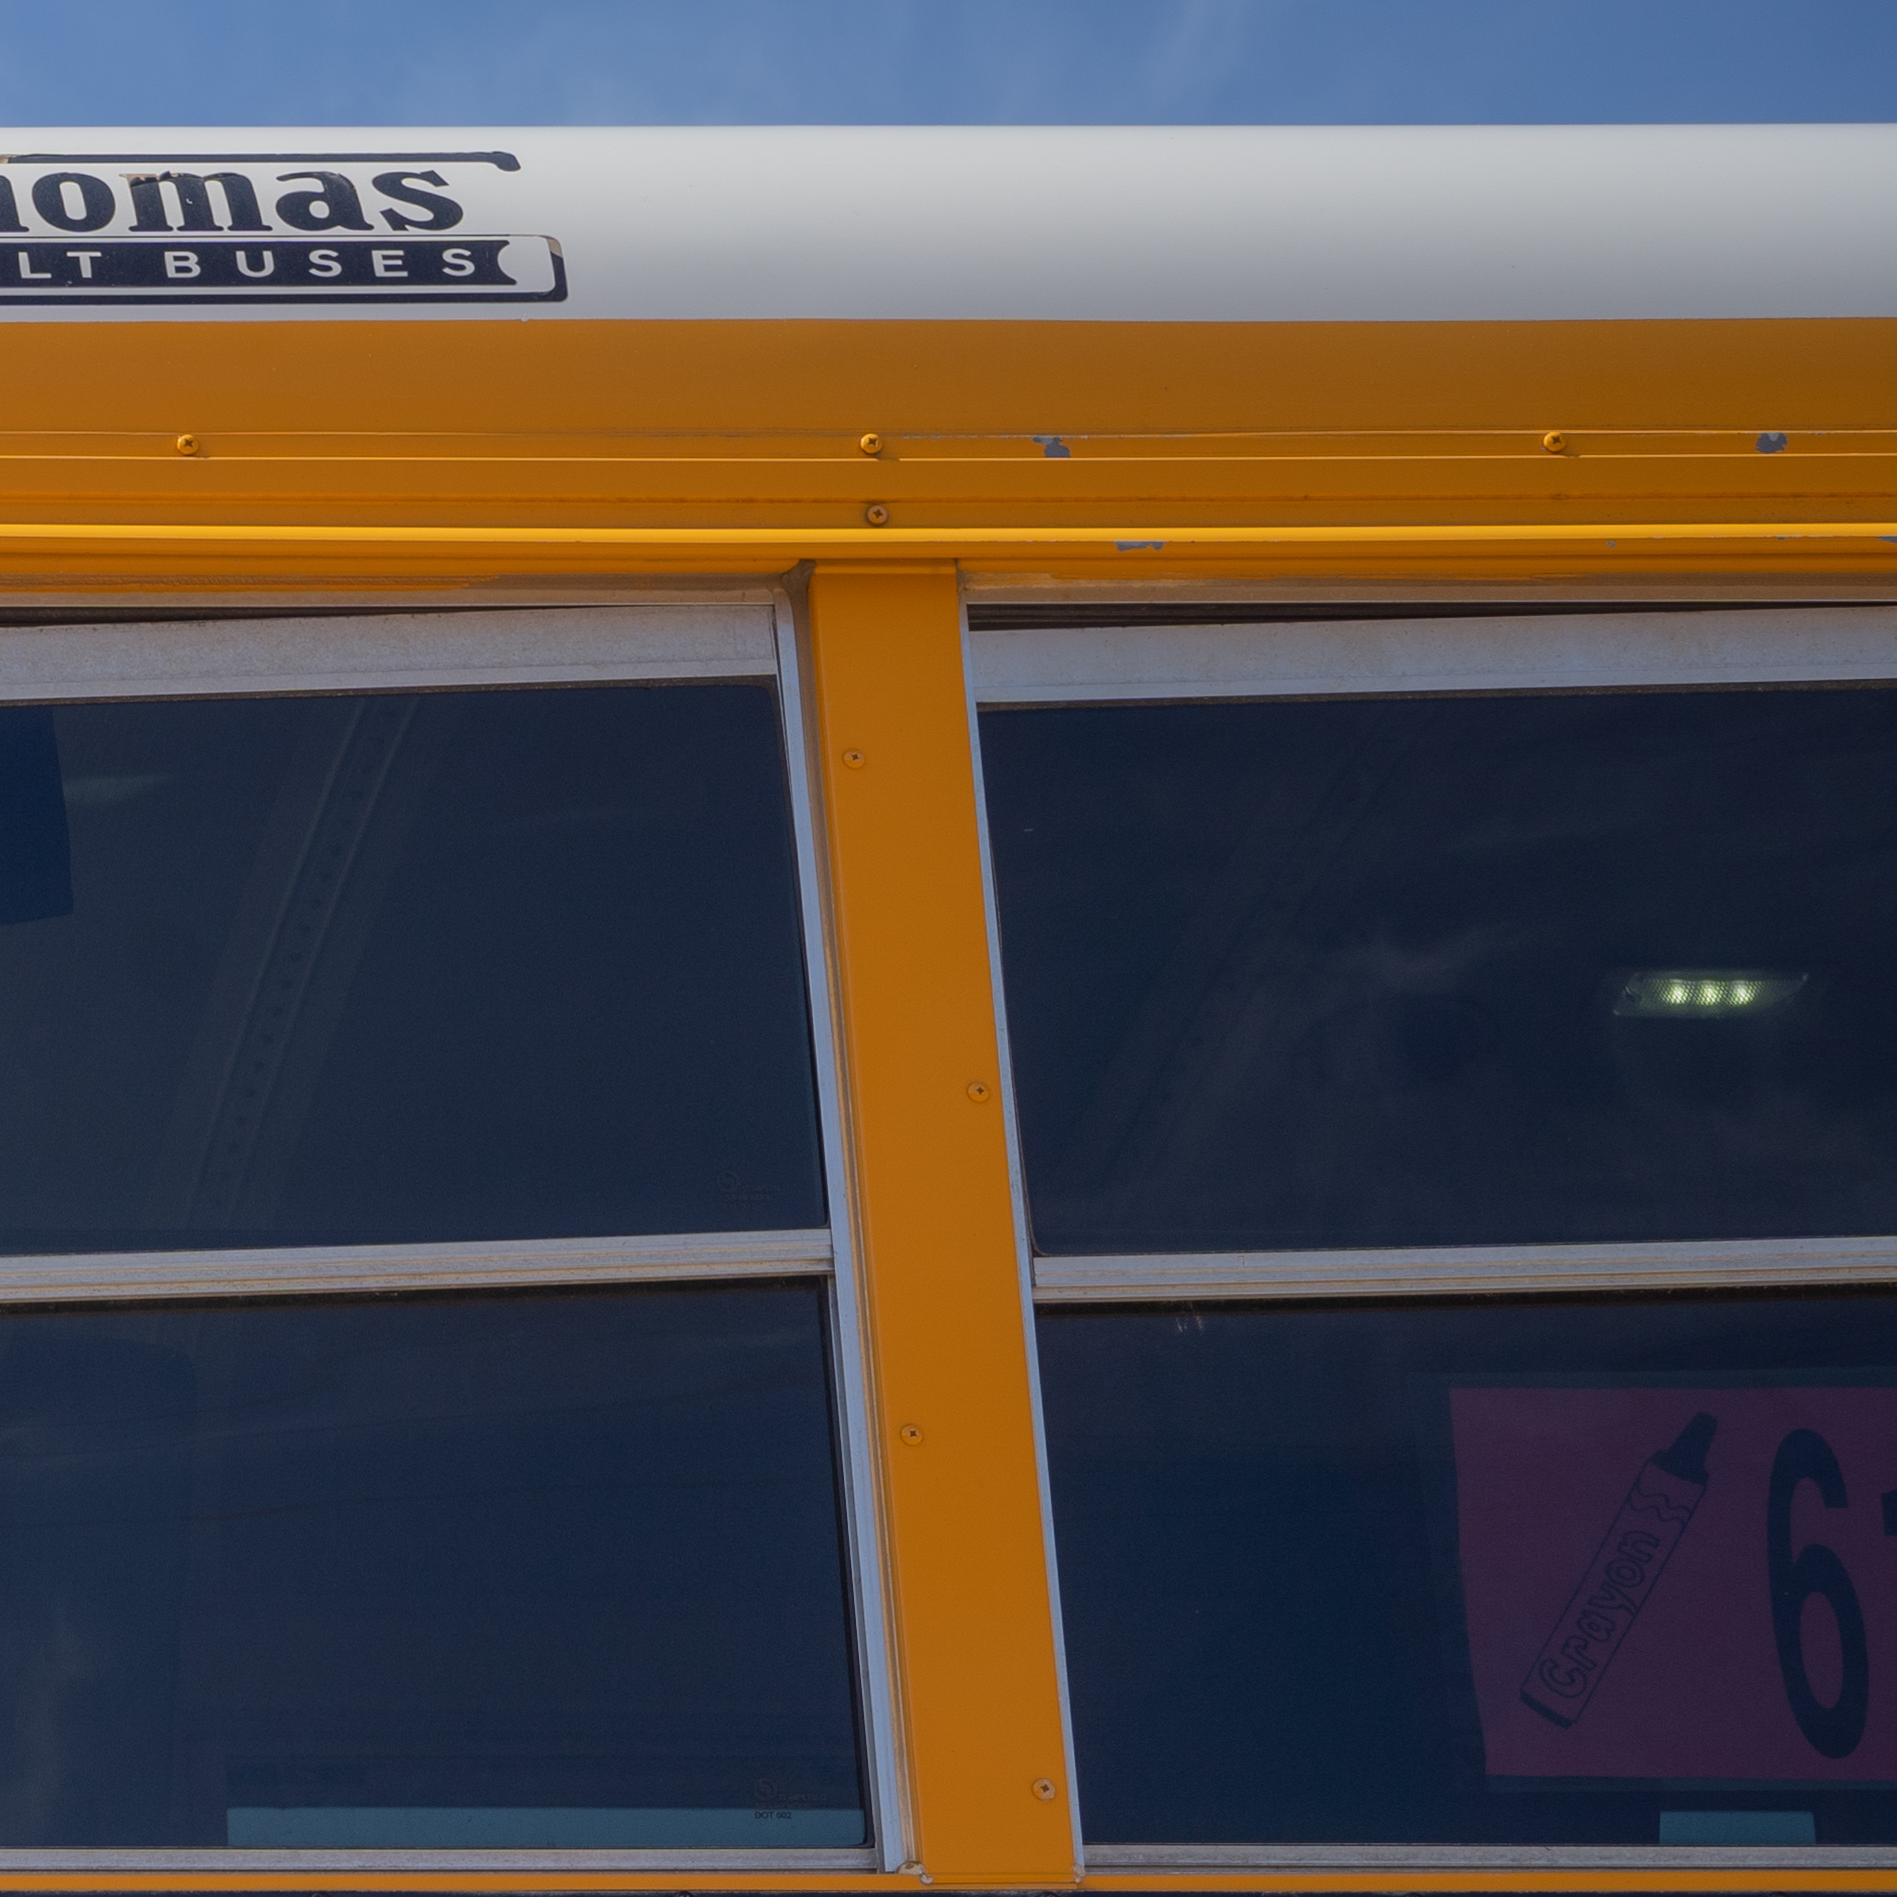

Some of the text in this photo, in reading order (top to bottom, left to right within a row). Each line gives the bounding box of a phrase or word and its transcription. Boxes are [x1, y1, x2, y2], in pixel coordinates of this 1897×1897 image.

[163, 246, 476, 279] BUSES
[1538, 1527, 1662, 1701] Crayon
[1766, 1427, 1897, 1760] 6
